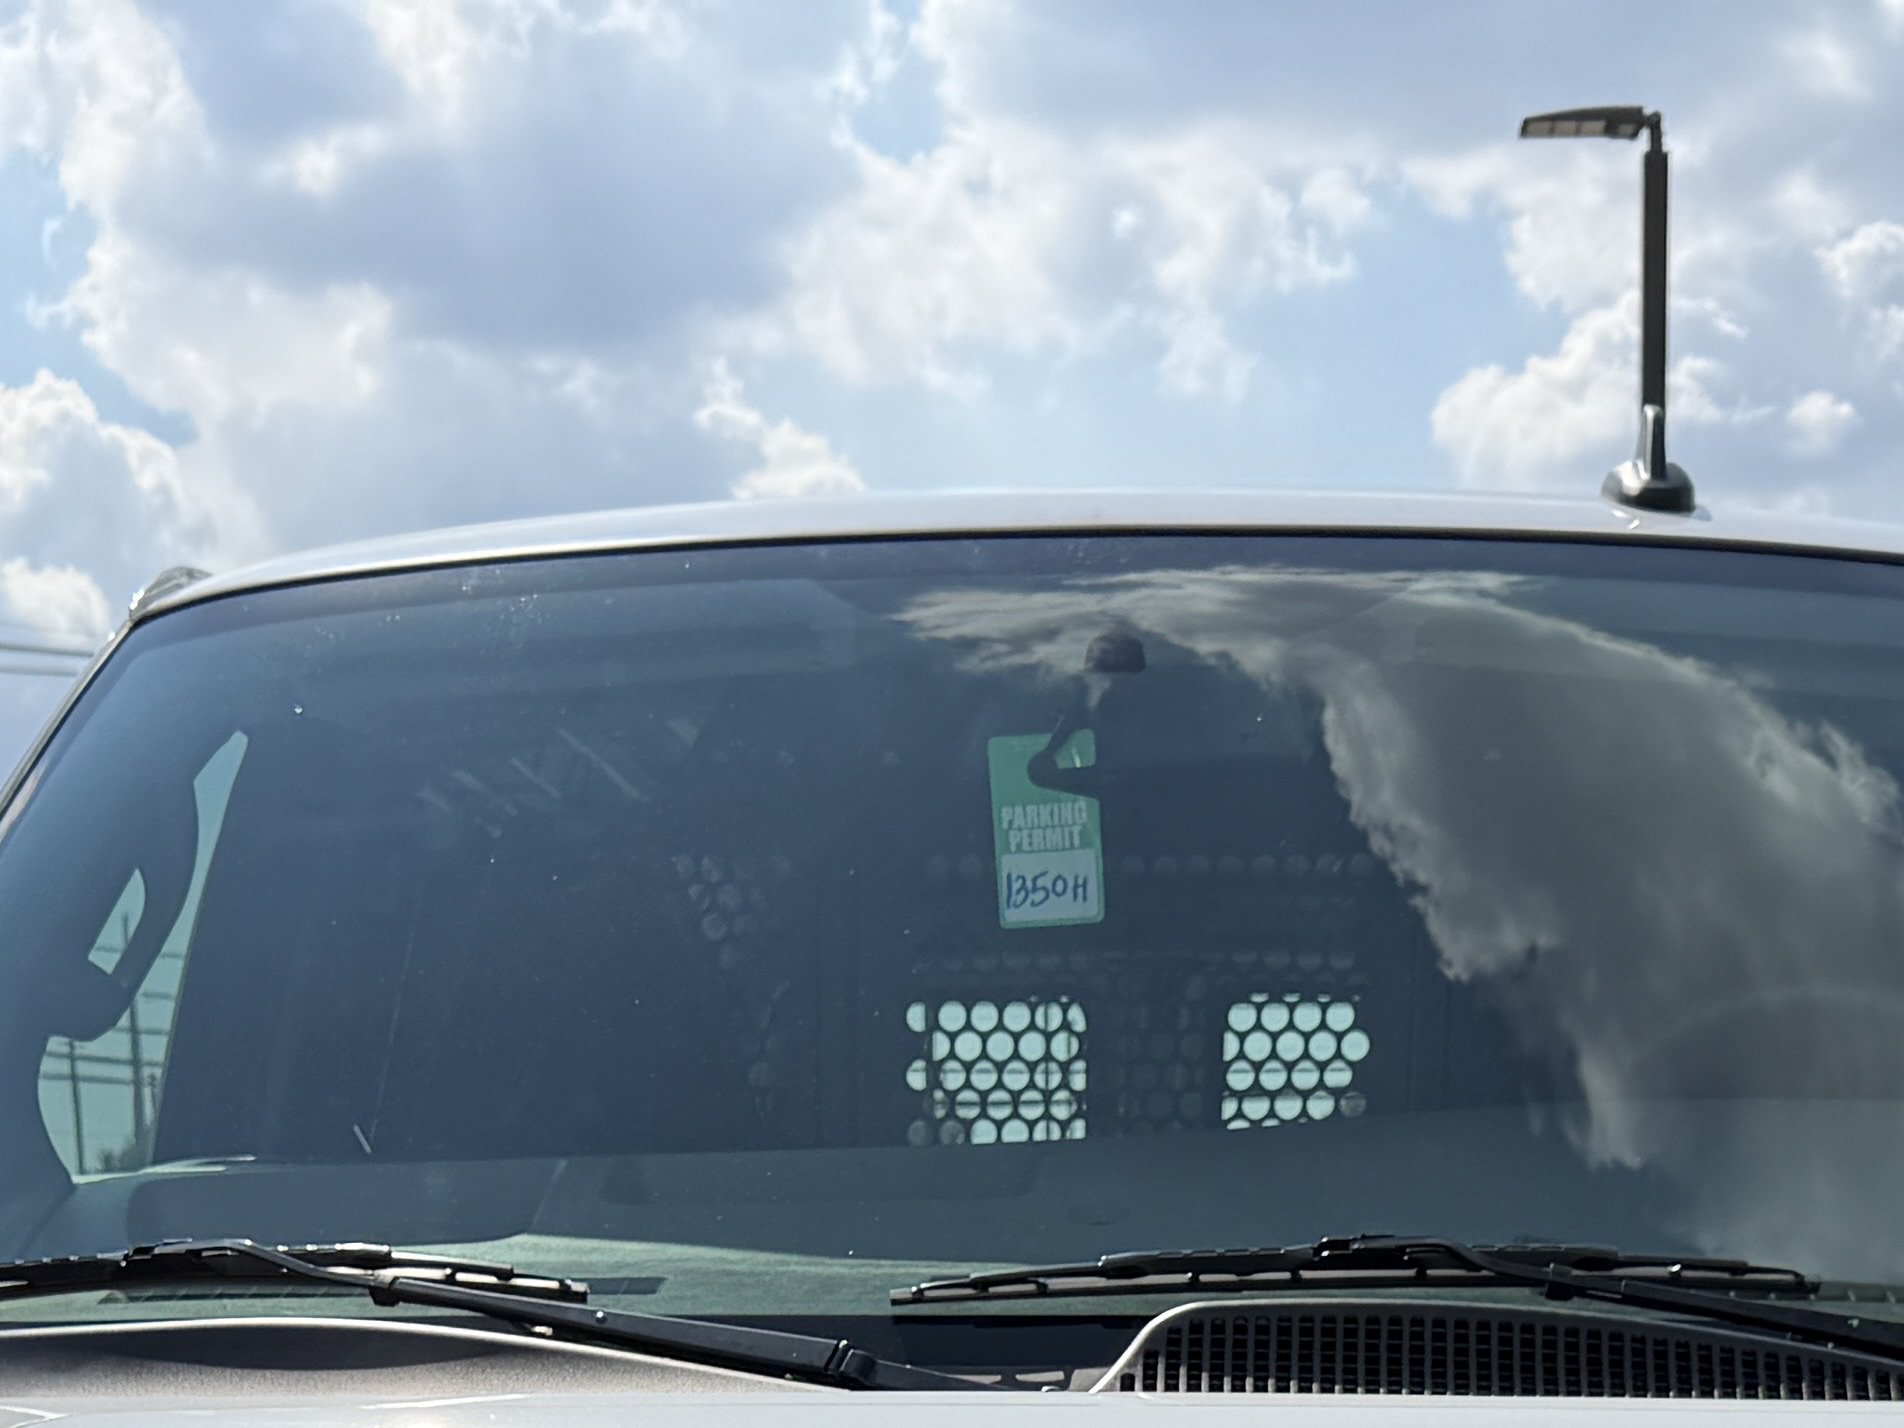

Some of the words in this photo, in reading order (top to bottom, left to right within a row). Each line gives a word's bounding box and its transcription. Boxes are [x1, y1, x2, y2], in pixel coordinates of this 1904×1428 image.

[1000, 800, 1088, 830] PARKING
[1008, 824, 1083, 852] PERMIT
[1005, 871, 1089, 909] 1350H
